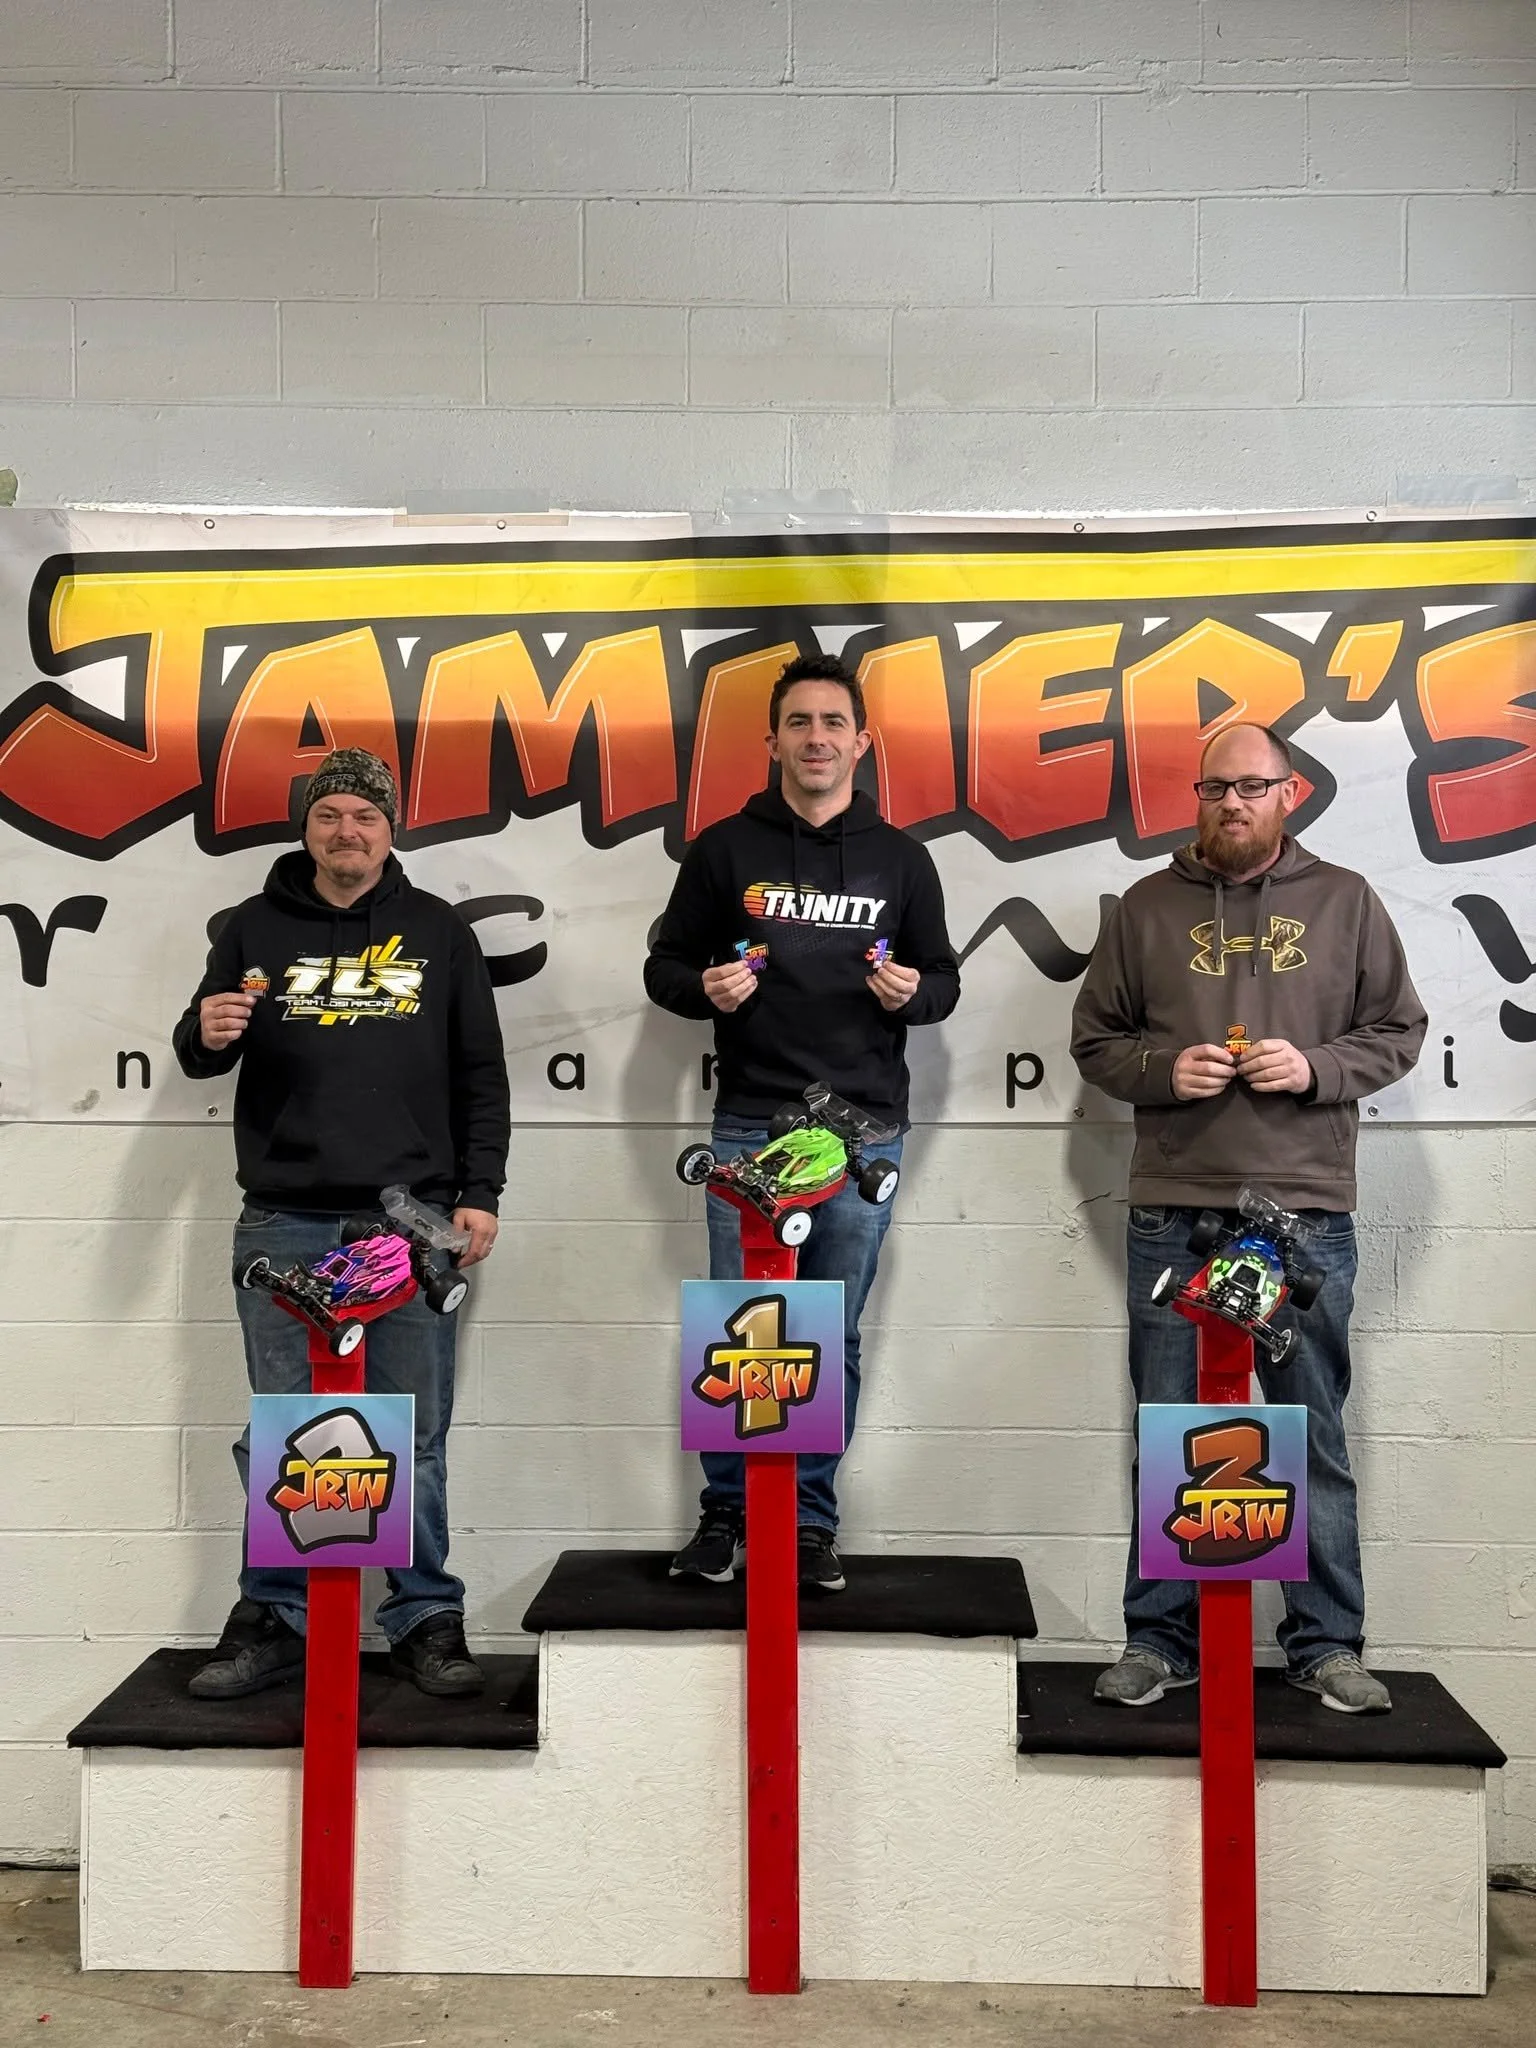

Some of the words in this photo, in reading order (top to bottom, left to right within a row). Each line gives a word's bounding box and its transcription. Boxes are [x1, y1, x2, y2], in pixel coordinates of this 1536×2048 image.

[764, 890, 887, 925] TRINITY
[284, 966, 424, 999] TLR
[321, 1000, 349, 1008] LOSI
[351, 1000, 396, 1008] RACING
[700, 1349, 814, 1401] JRW
[732, 1301, 781, 1432] 1
[274, 1458, 389, 1512] JRW
[1170, 1489, 1288, 1541] JRW
